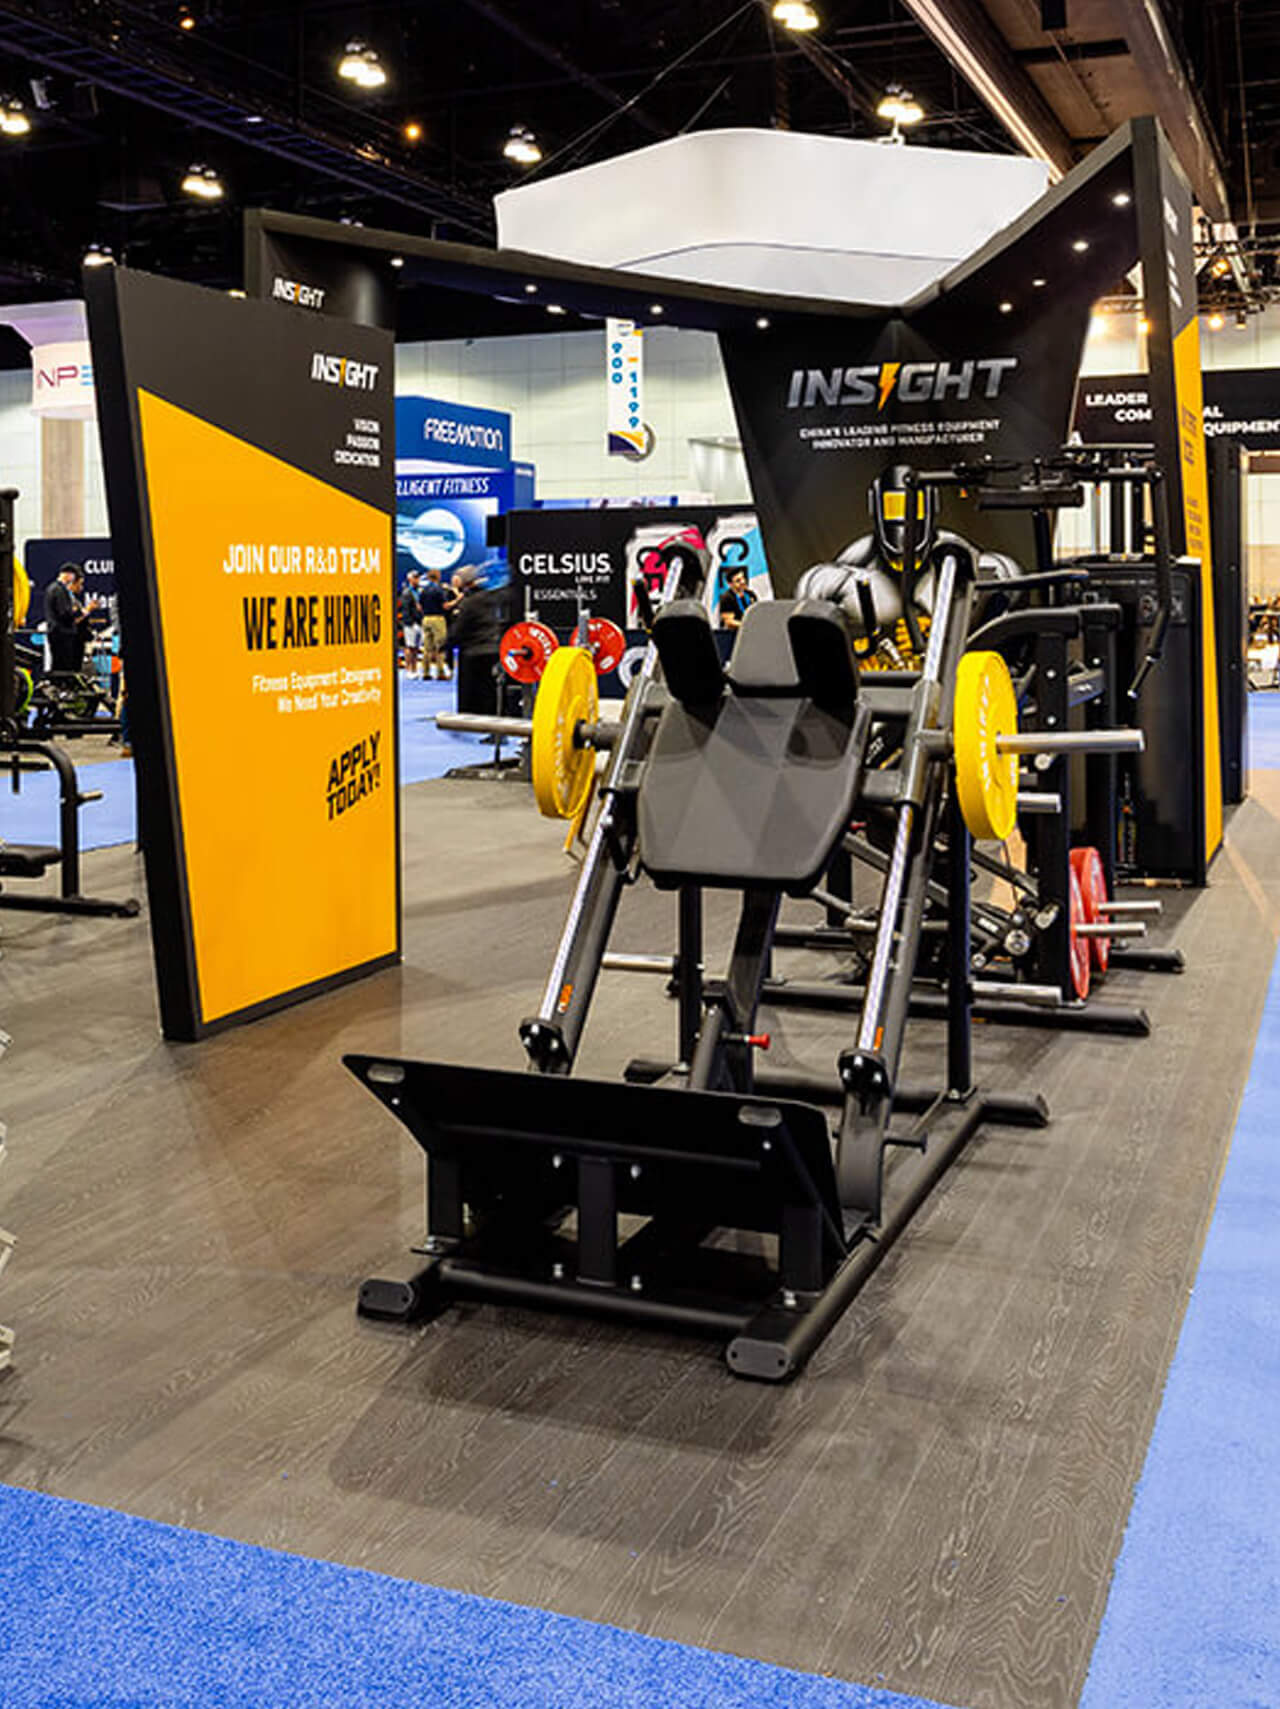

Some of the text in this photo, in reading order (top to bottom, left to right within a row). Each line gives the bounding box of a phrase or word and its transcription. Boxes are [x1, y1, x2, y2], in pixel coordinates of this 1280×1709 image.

[787, 358, 1018, 411] INSIGHT
[1085, 391, 1149, 407] LEADER
[423, 417, 503, 452] FREEMOTION
[938, 419, 1000, 432] EQUIPMENT
[1203, 419, 1280, 437] QUIPMEN
[223, 544, 381, 574] JOIN OUR R&D TEAM
[519, 553, 611, 575] CELSIUS
[243, 594, 381, 651] WE ARE HIRING
[326, 731, 380, 792] APPLY
[326, 763, 380, 820] TODAY!
